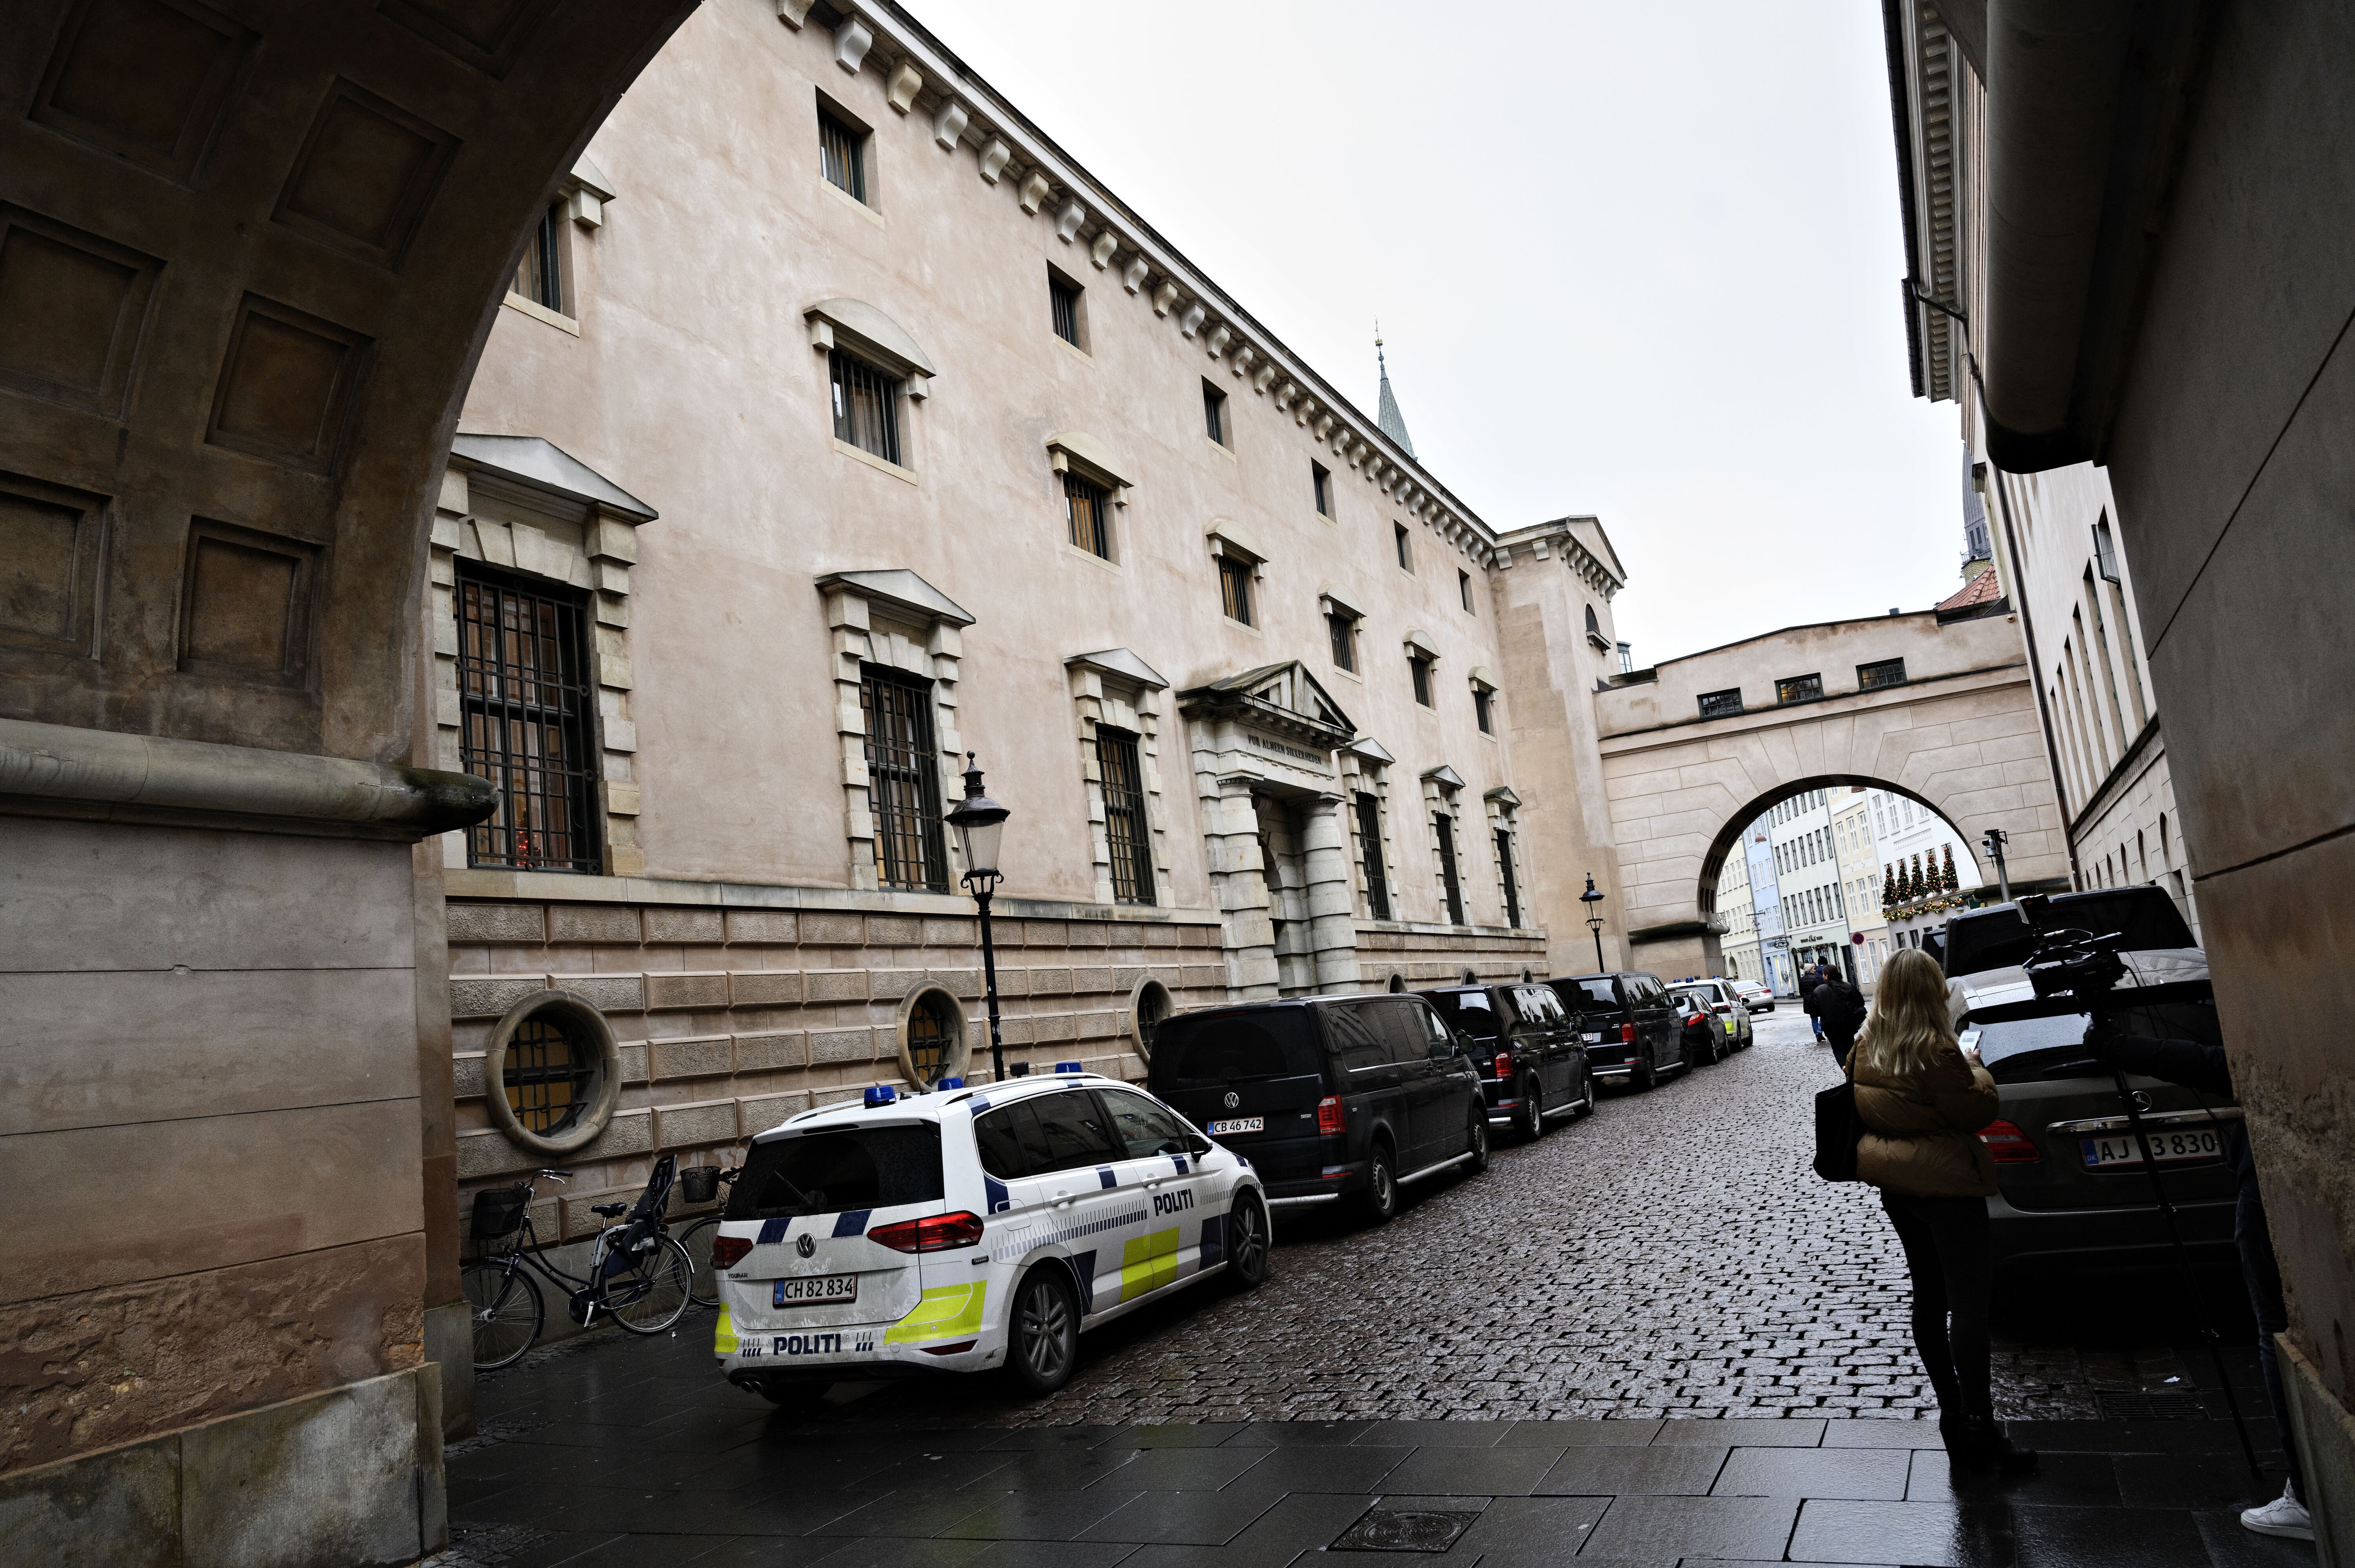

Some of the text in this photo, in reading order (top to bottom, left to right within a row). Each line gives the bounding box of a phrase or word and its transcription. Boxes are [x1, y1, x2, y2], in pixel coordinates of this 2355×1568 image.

[1248, 734, 1322, 765] FOR ALMEEN SIKKERHEDEN
[1215, 1119, 1261, 1132] CB 46 742
[2101, 1140, 2129, 1160] AJ
[2171, 1133, 2216, 1154] 830
[1153, 1188, 1194, 1216] POLITI
[785, 1278, 853, 1298] CH 82 834
[774, 1334, 841, 1355] POLITI
